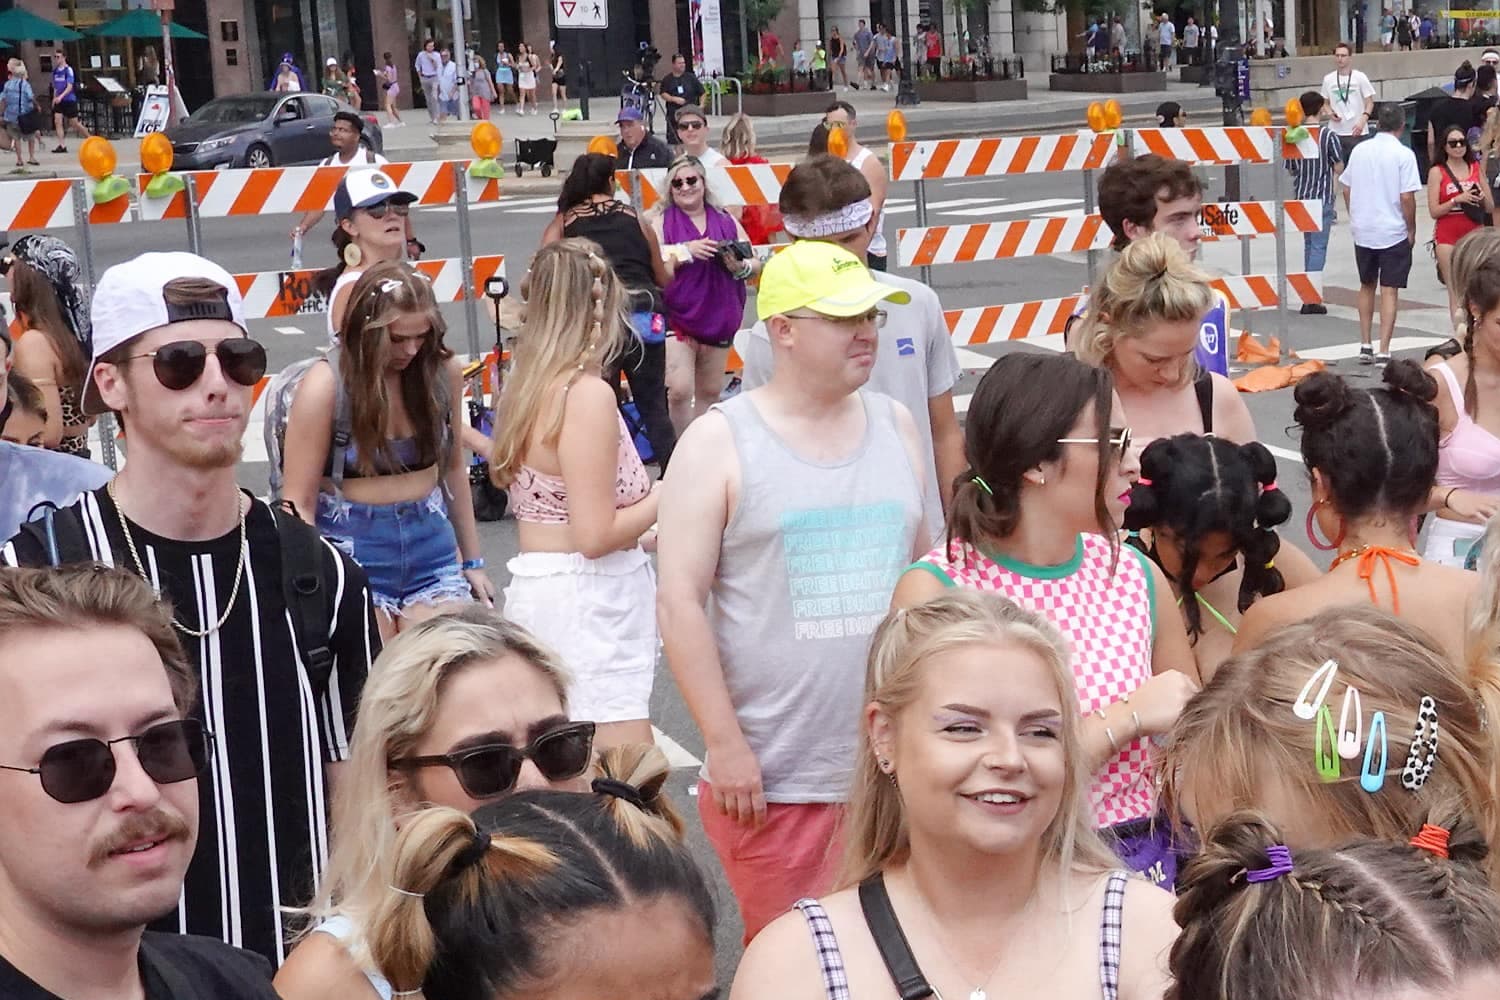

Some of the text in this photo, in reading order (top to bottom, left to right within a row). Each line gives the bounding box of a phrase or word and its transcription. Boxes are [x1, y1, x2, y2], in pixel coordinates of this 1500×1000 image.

[1195, 203, 1239, 226] dSafe
[792, 597, 842, 618] FREE
[794, 619, 844, 640] FREE
